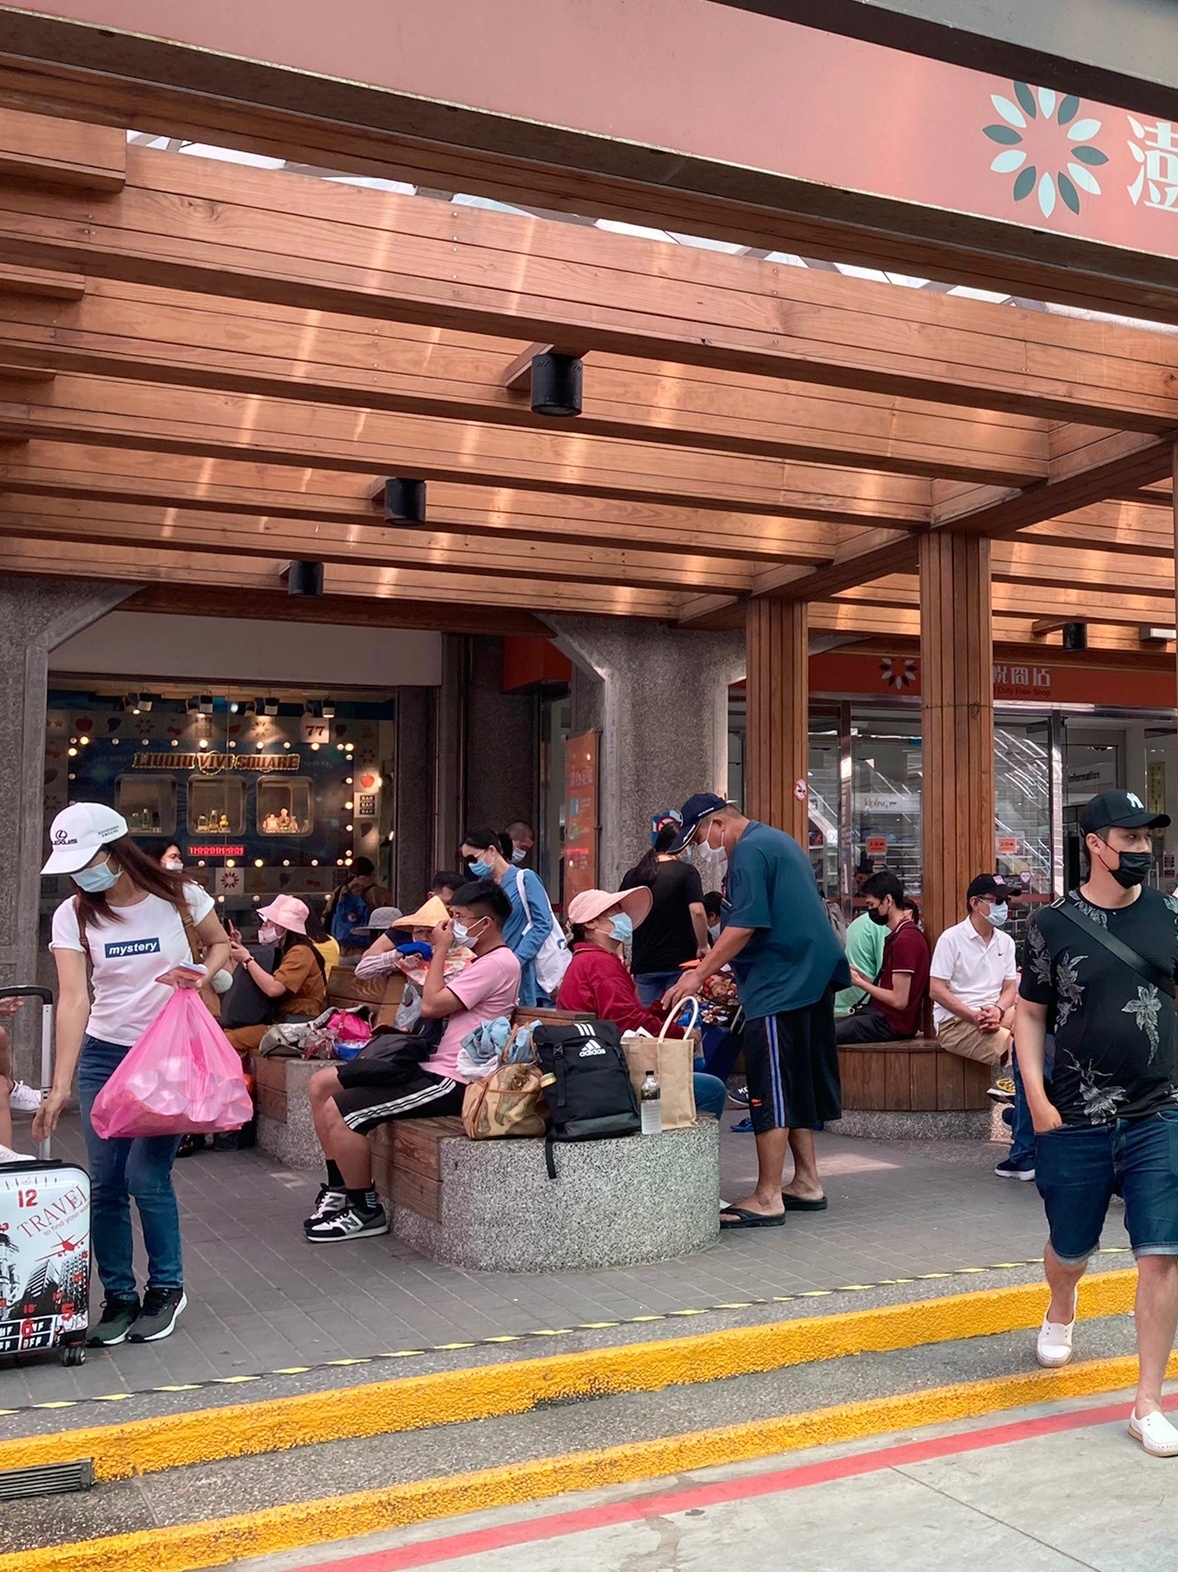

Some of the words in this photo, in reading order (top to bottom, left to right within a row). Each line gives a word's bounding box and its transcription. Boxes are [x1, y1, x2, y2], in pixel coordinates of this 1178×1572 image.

[305, 725, 325, 736] 77
[237, 755, 299, 769] SQUARE
[109, 942, 158, 955] mystery
[579, 1048, 606, 1057] adidas
[18, 1188, 38, 1208] 12
[17, 1184, 89, 1238] TRAVEL
